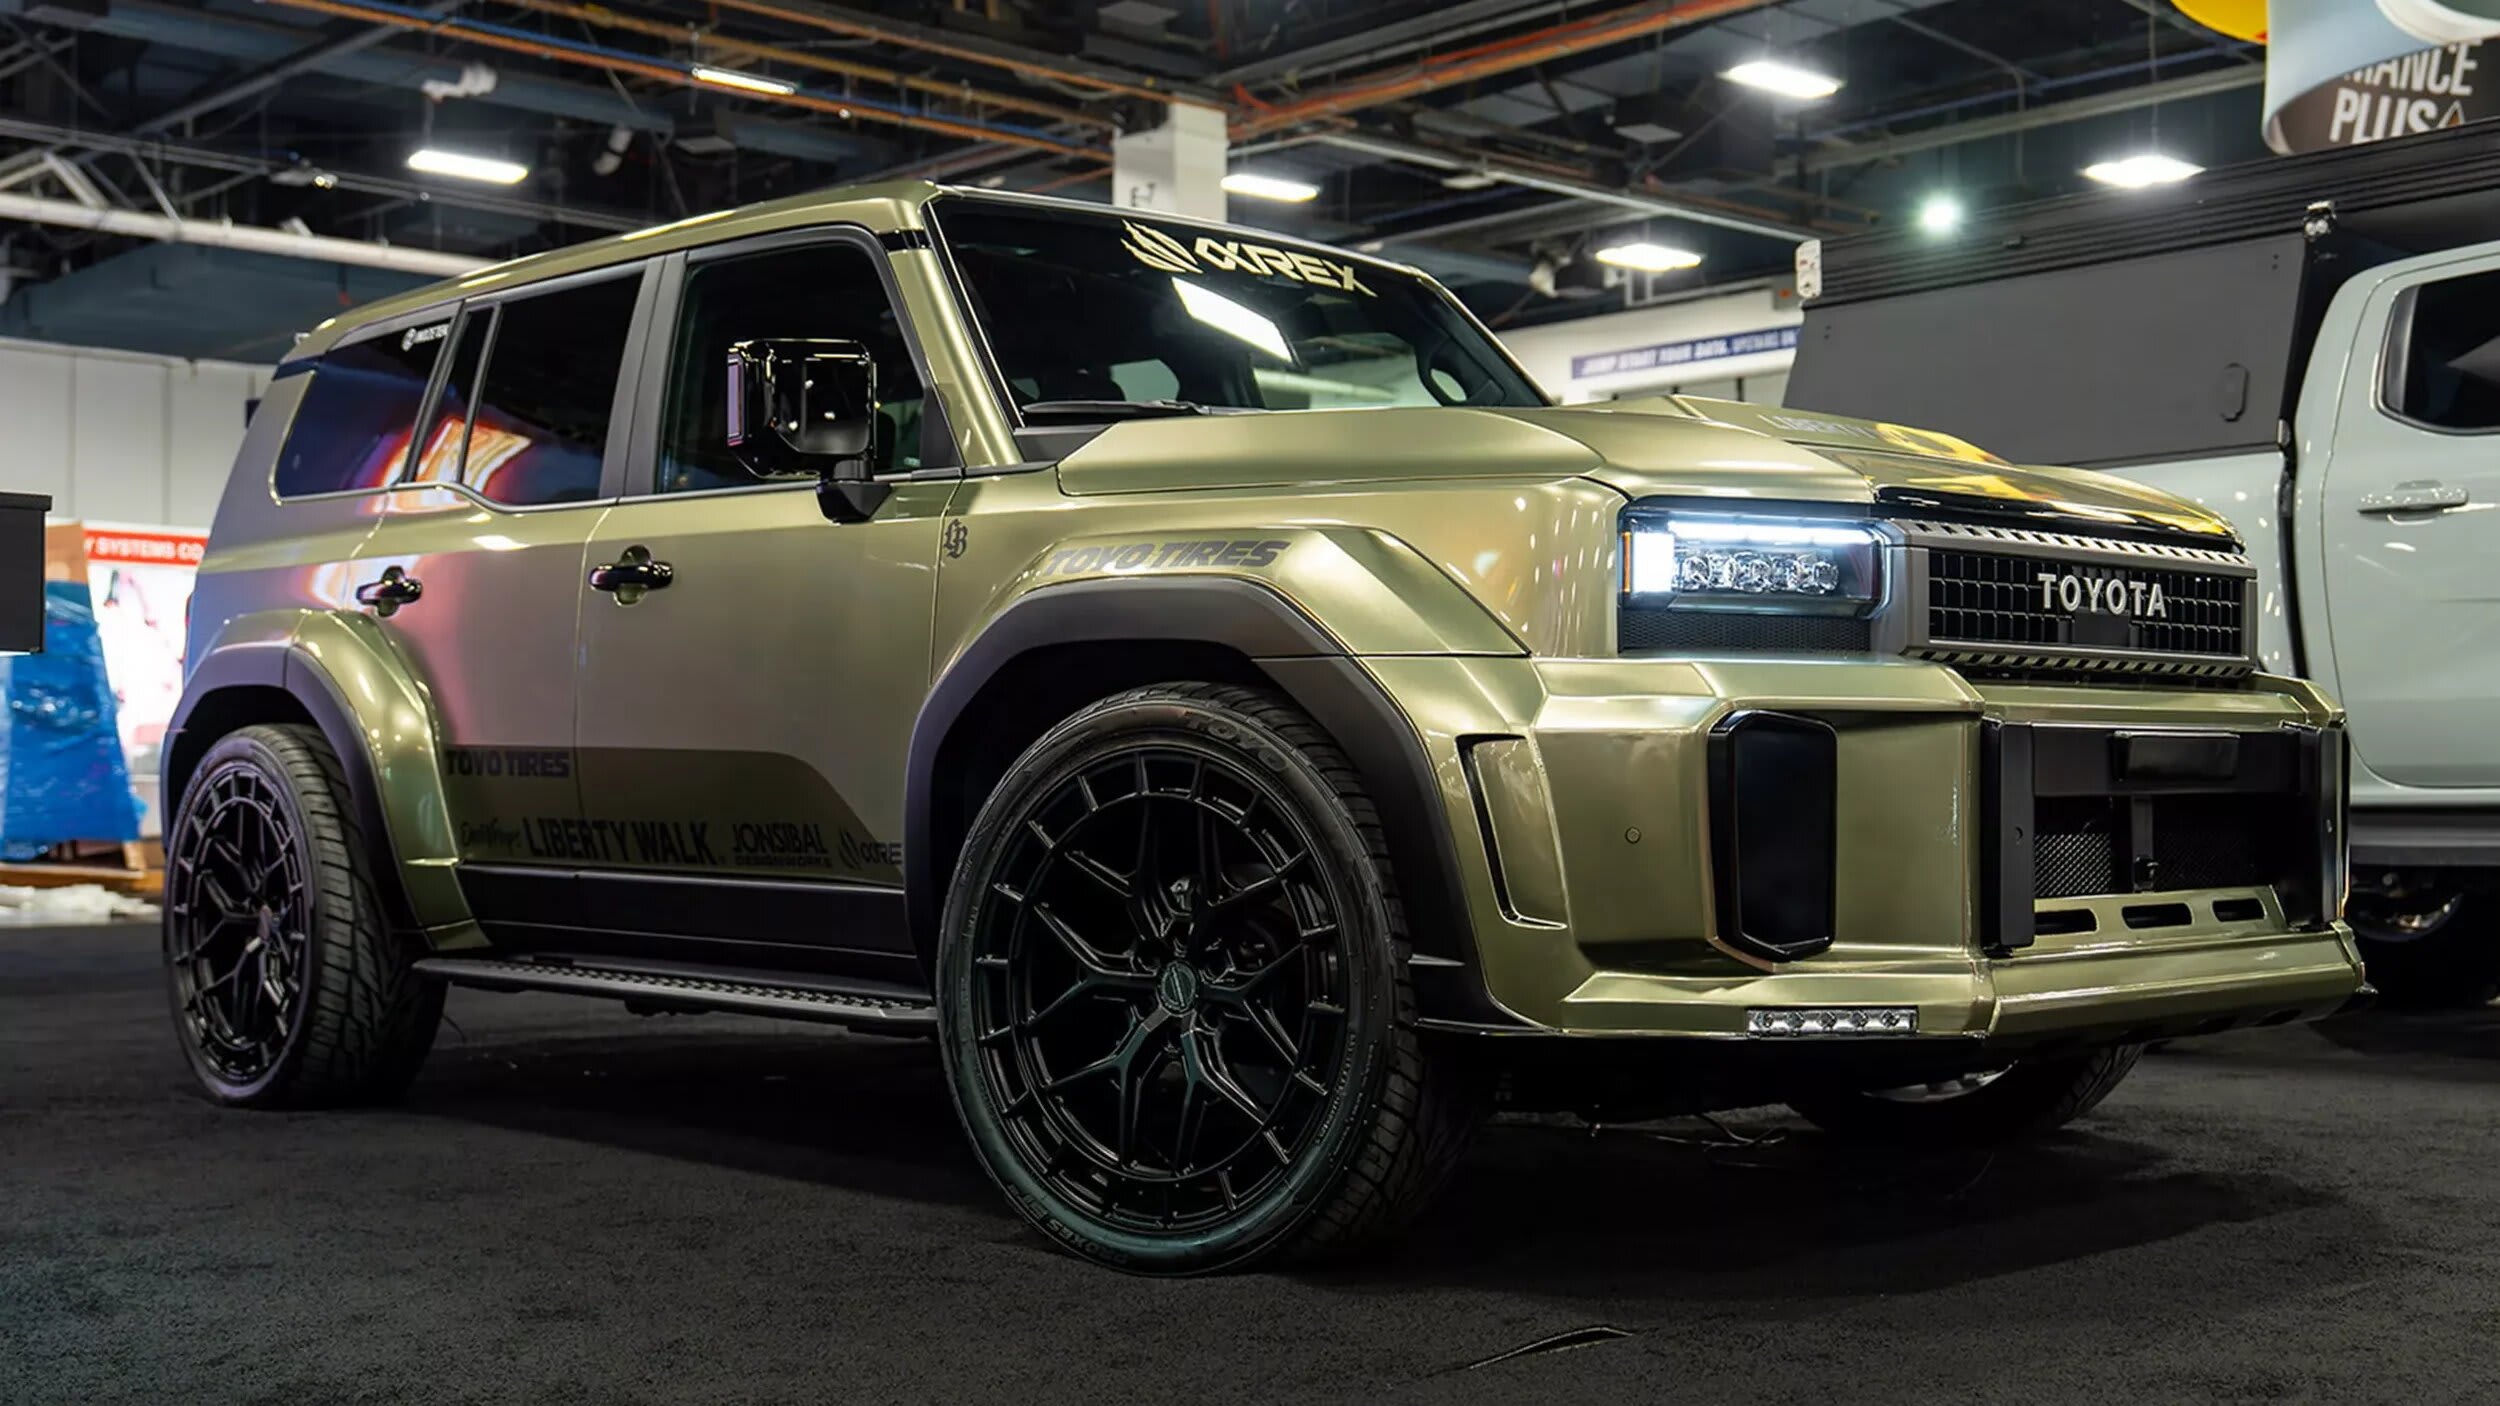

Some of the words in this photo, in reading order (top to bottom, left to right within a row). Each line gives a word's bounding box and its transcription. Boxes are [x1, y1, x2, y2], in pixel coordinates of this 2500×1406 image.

[1045, 545, 1151, 575] TOYO
[1154, 540, 1292, 568] TIRES
[2037, 573, 2167, 618] TOYOTA
[446, 750, 502, 777] TOYO
[505, 751, 570, 778] TIRES
[522, 817, 630, 862] LIBERTY
[631, 821, 718, 866] WALK
[732, 822, 828, 854] JONSIBAL
